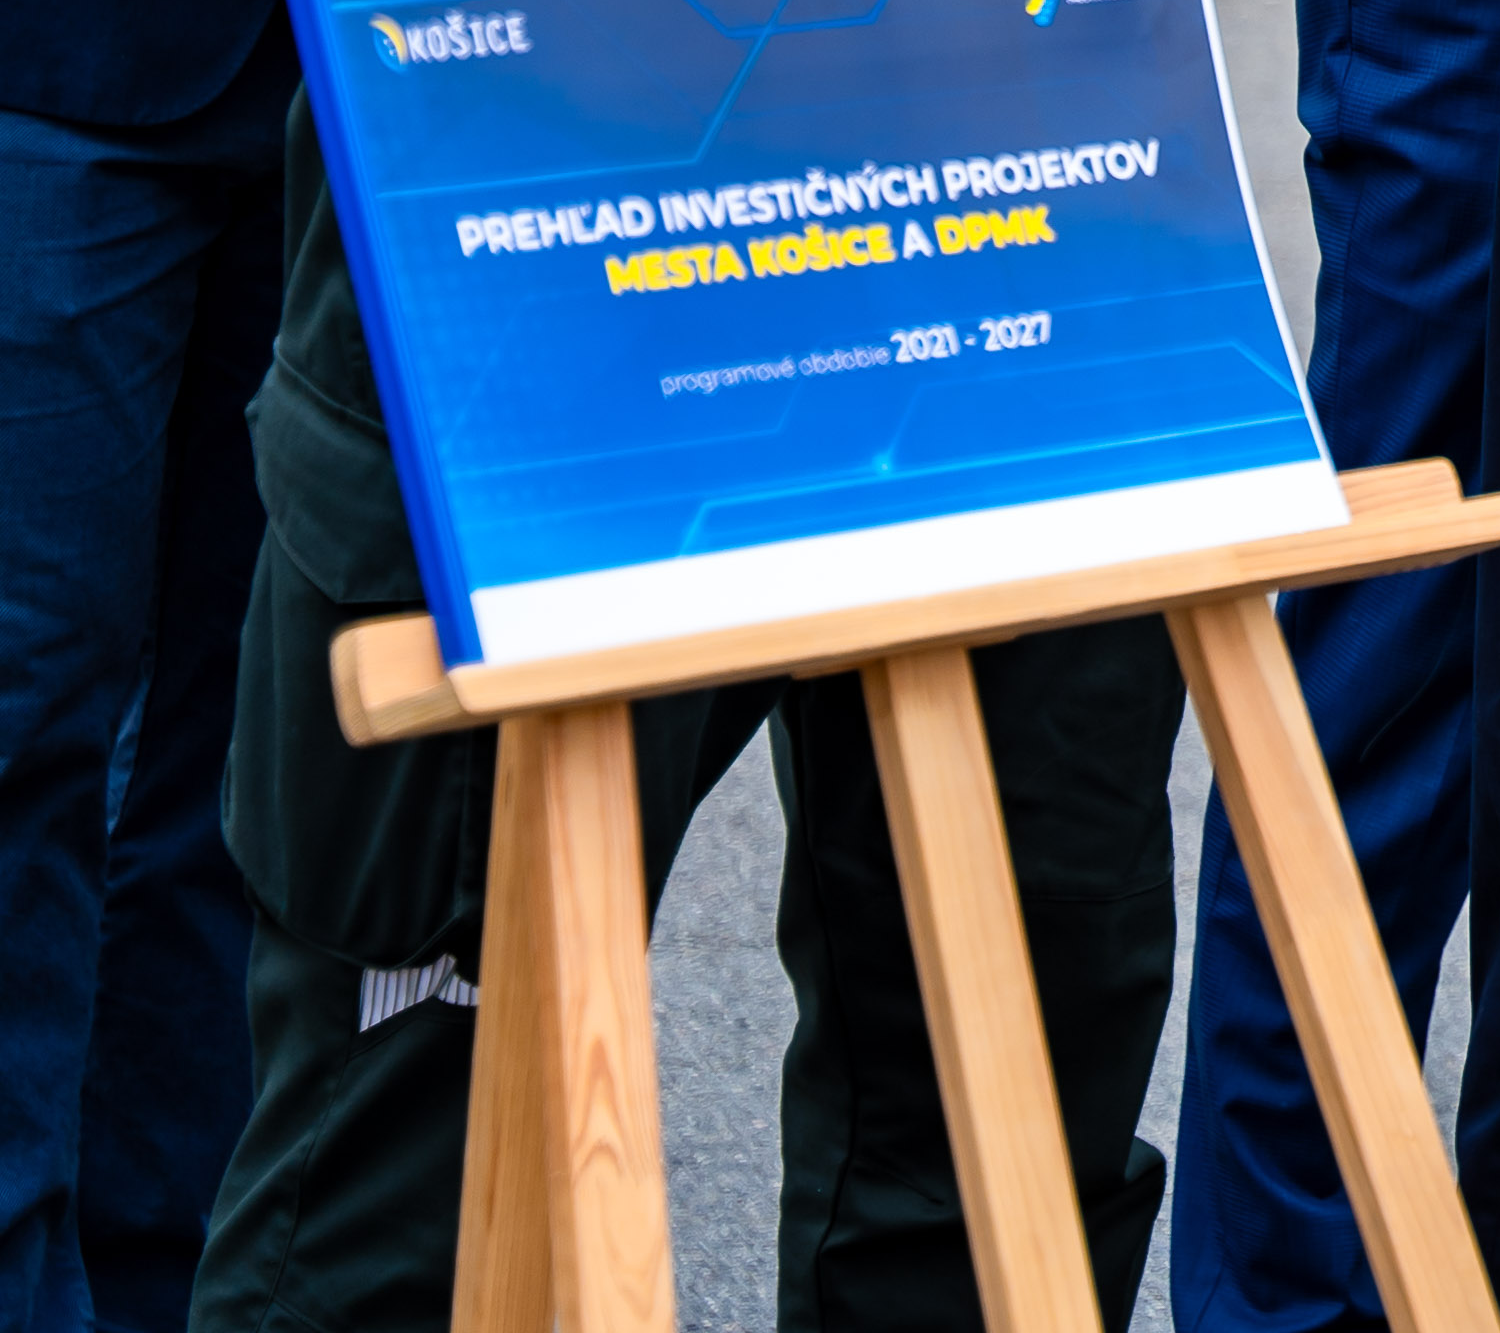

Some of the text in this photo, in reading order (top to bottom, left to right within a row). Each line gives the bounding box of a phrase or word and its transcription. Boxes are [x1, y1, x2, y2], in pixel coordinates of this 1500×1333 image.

[405, 9, 533, 64] KOŠICE
[456, 138, 1161, 257] PREHĽAD INVESTIČNÝCH PROJEKTOV
[605, 205, 1057, 295] MESTA KOŠICE A DPMK
[660, 355, 797, 399] programové
[799, 343, 891, 377] obdobie
[889, 325, 961, 364] 2021
[978, 311, 1053, 353] 2027
